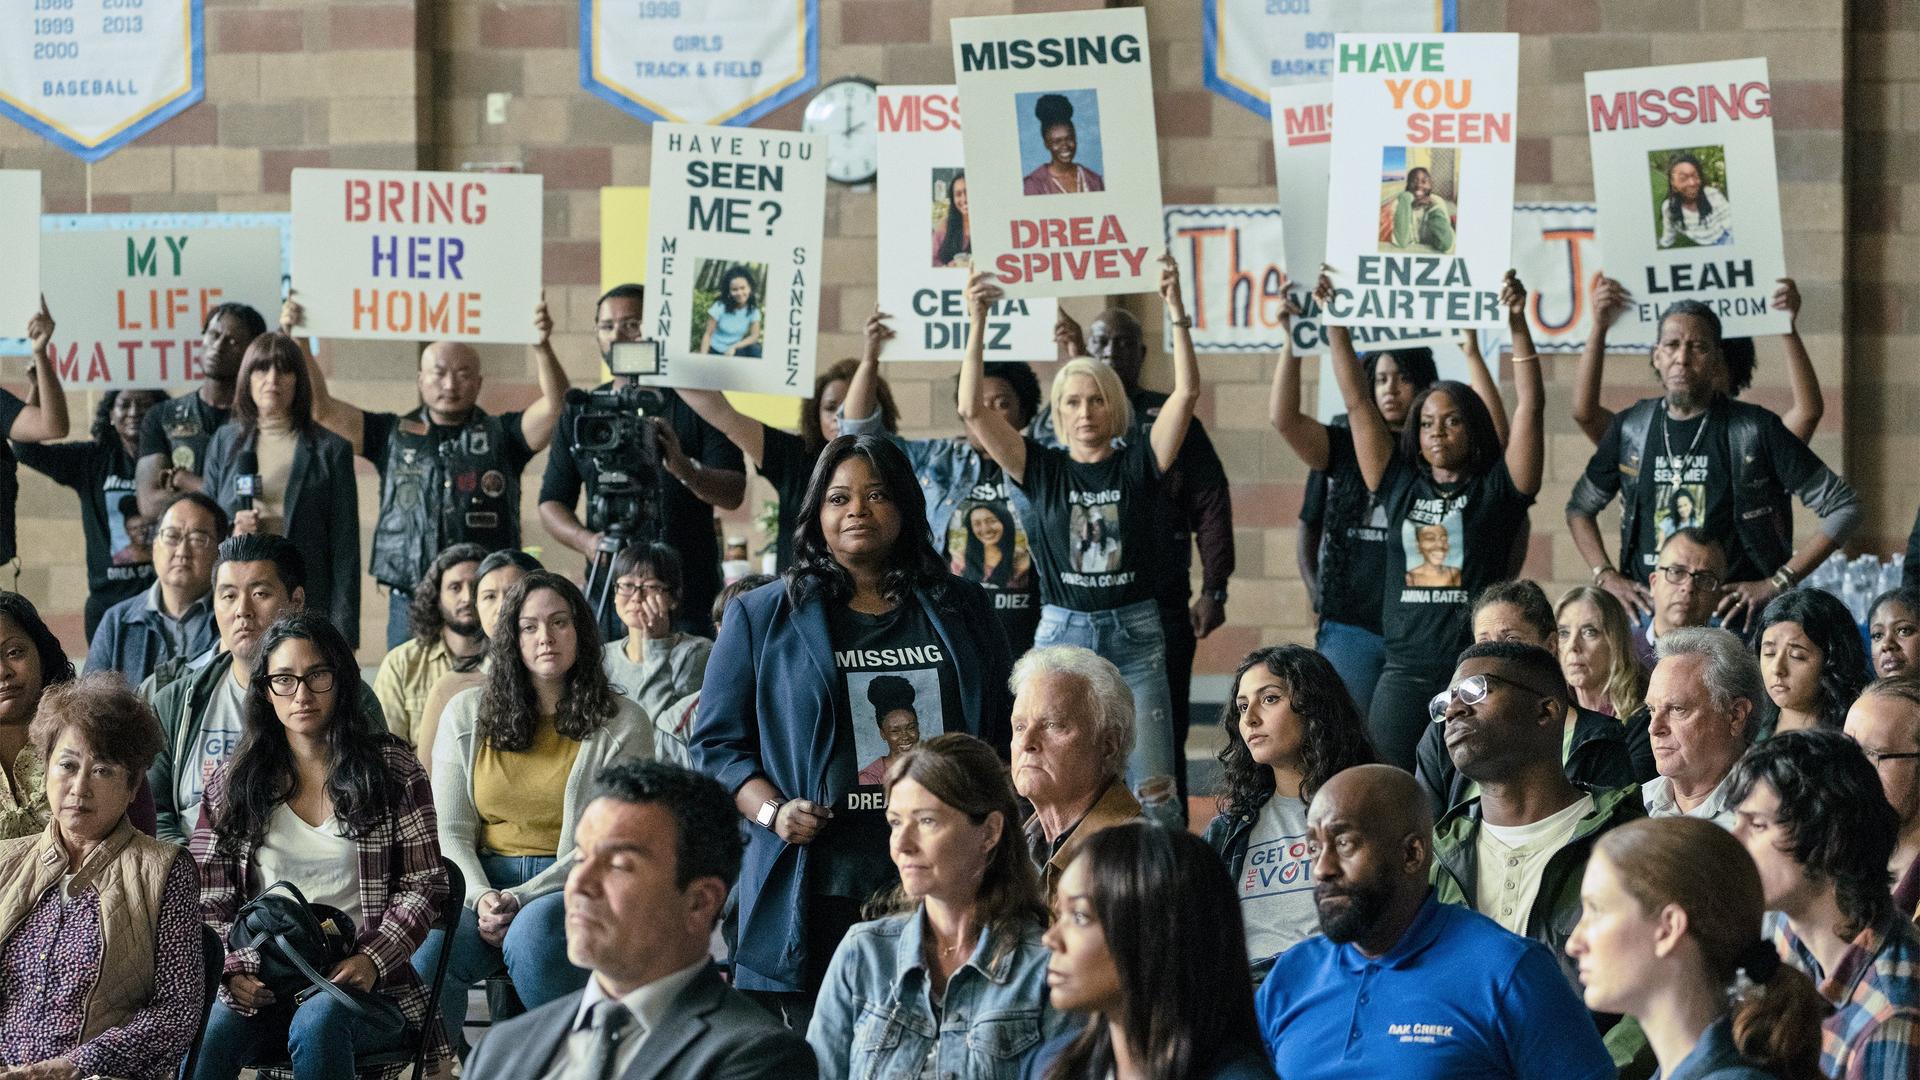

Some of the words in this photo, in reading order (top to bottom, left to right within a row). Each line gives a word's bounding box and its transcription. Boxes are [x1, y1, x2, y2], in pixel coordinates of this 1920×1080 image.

[103, 15, 143, 33] 2013
[34, 41, 79, 60] 2000
[673, 35, 724, 52] GIRLS
[960, 34, 1142, 72] MISSING
[1339, 42, 1445, 73] HAVE
[634, 61, 689, 78] TRACK
[696, 61, 707, 77] &
[714, 60, 763, 77] FIELD
[43, 80, 138, 96] BASEBALL
[1384, 79, 1472, 110] YOU
[1590, 80, 1771, 132] MISSING
[1406, 113, 1511, 143] SEEN
[669, 133, 744, 155] HAVE
[760, 139, 812, 161] YOU
[687, 160, 783, 192] SEEN
[345, 179, 487, 225] BRING
[688, 195, 782, 236] ME?
[1010, 214, 1128, 249] DREA
[127, 236, 189, 277] MY
[372, 235, 465, 280] HER
[996, 247, 1149, 285] SPIVEY
[1358, 255, 1472, 287] ENZA
[1177, 225, 1288, 330] The
[1646, 259, 1755, 295] LEAH
[353, 288, 481, 335] HOME
[786, 247, 806, 386] SANCHEZ
[912, 288, 1030, 317] CEIA
[1328, 288, 1500, 321] CARTER
[1069, 490, 1121, 506] MSSING
[995, 594, 1030, 609] DIEZ
[1432, 590, 1469, 603] BATES
[835, 644, 944, 668] MISSING
[847, 792, 888, 811] DRE
[1251, 846, 1286, 866] GET
[1245, 868, 1258, 891] THE
